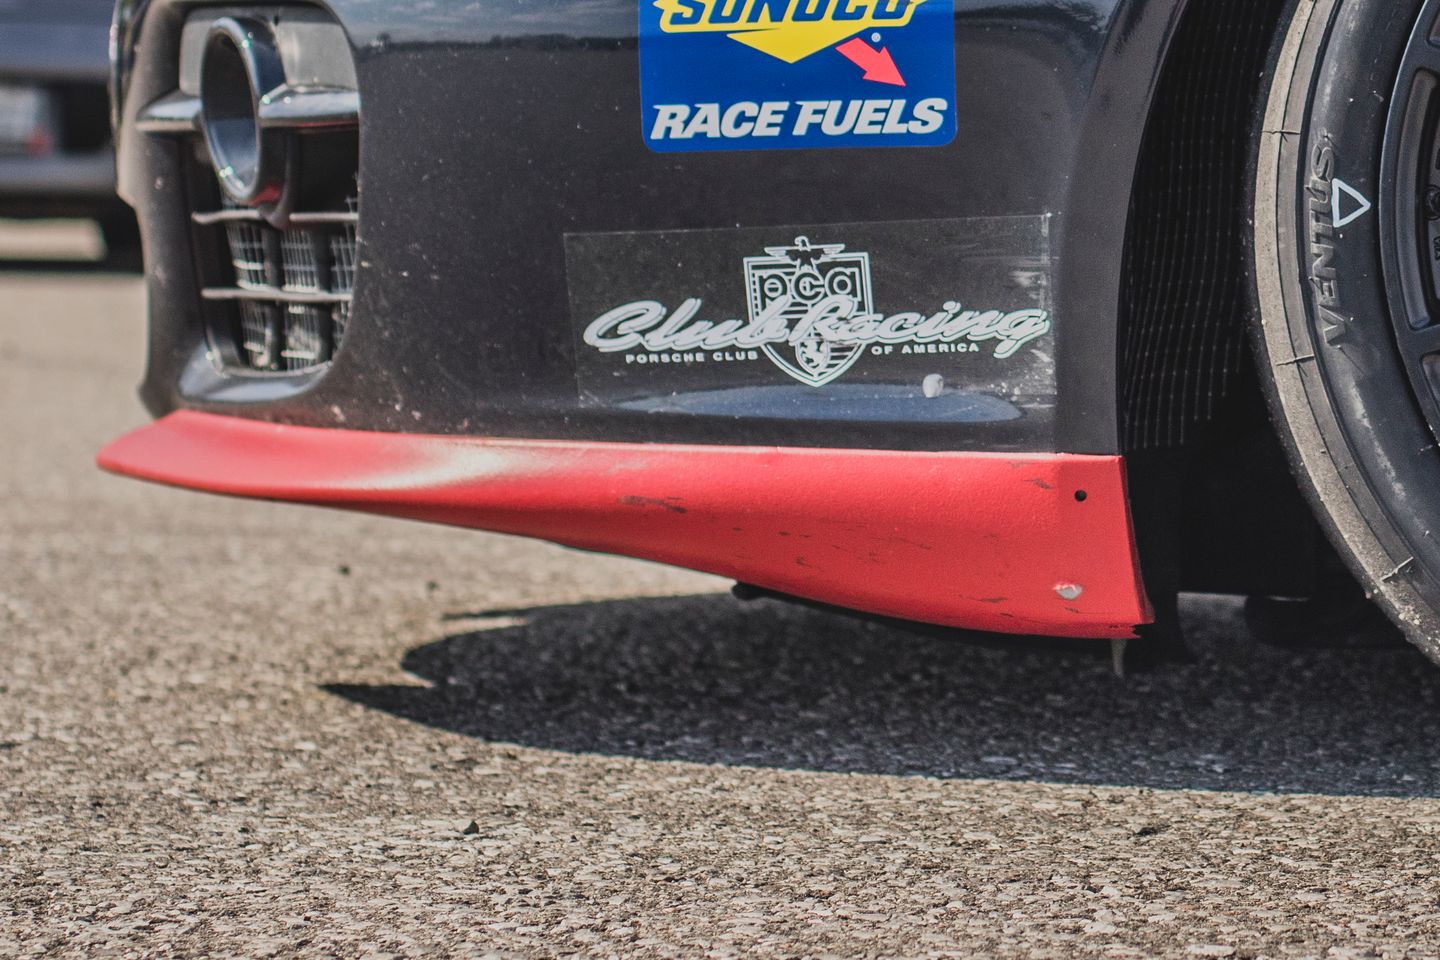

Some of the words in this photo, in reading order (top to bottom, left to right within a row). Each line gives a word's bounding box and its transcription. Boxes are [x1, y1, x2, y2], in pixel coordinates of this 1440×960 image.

[650, 101, 788, 140] RACE
[792, 97, 948, 136] FUELS
[1308, 143, 1346, 345] VENTUS
[583, 294, 791, 352] Club
[788, 294, 1050, 359] Racing
[625, 352, 705, 365] PORSCHE
[712, 350, 759, 362] CLUB
[871, 345, 894, 356] OF
[901, 341, 980, 355] AMERICA
